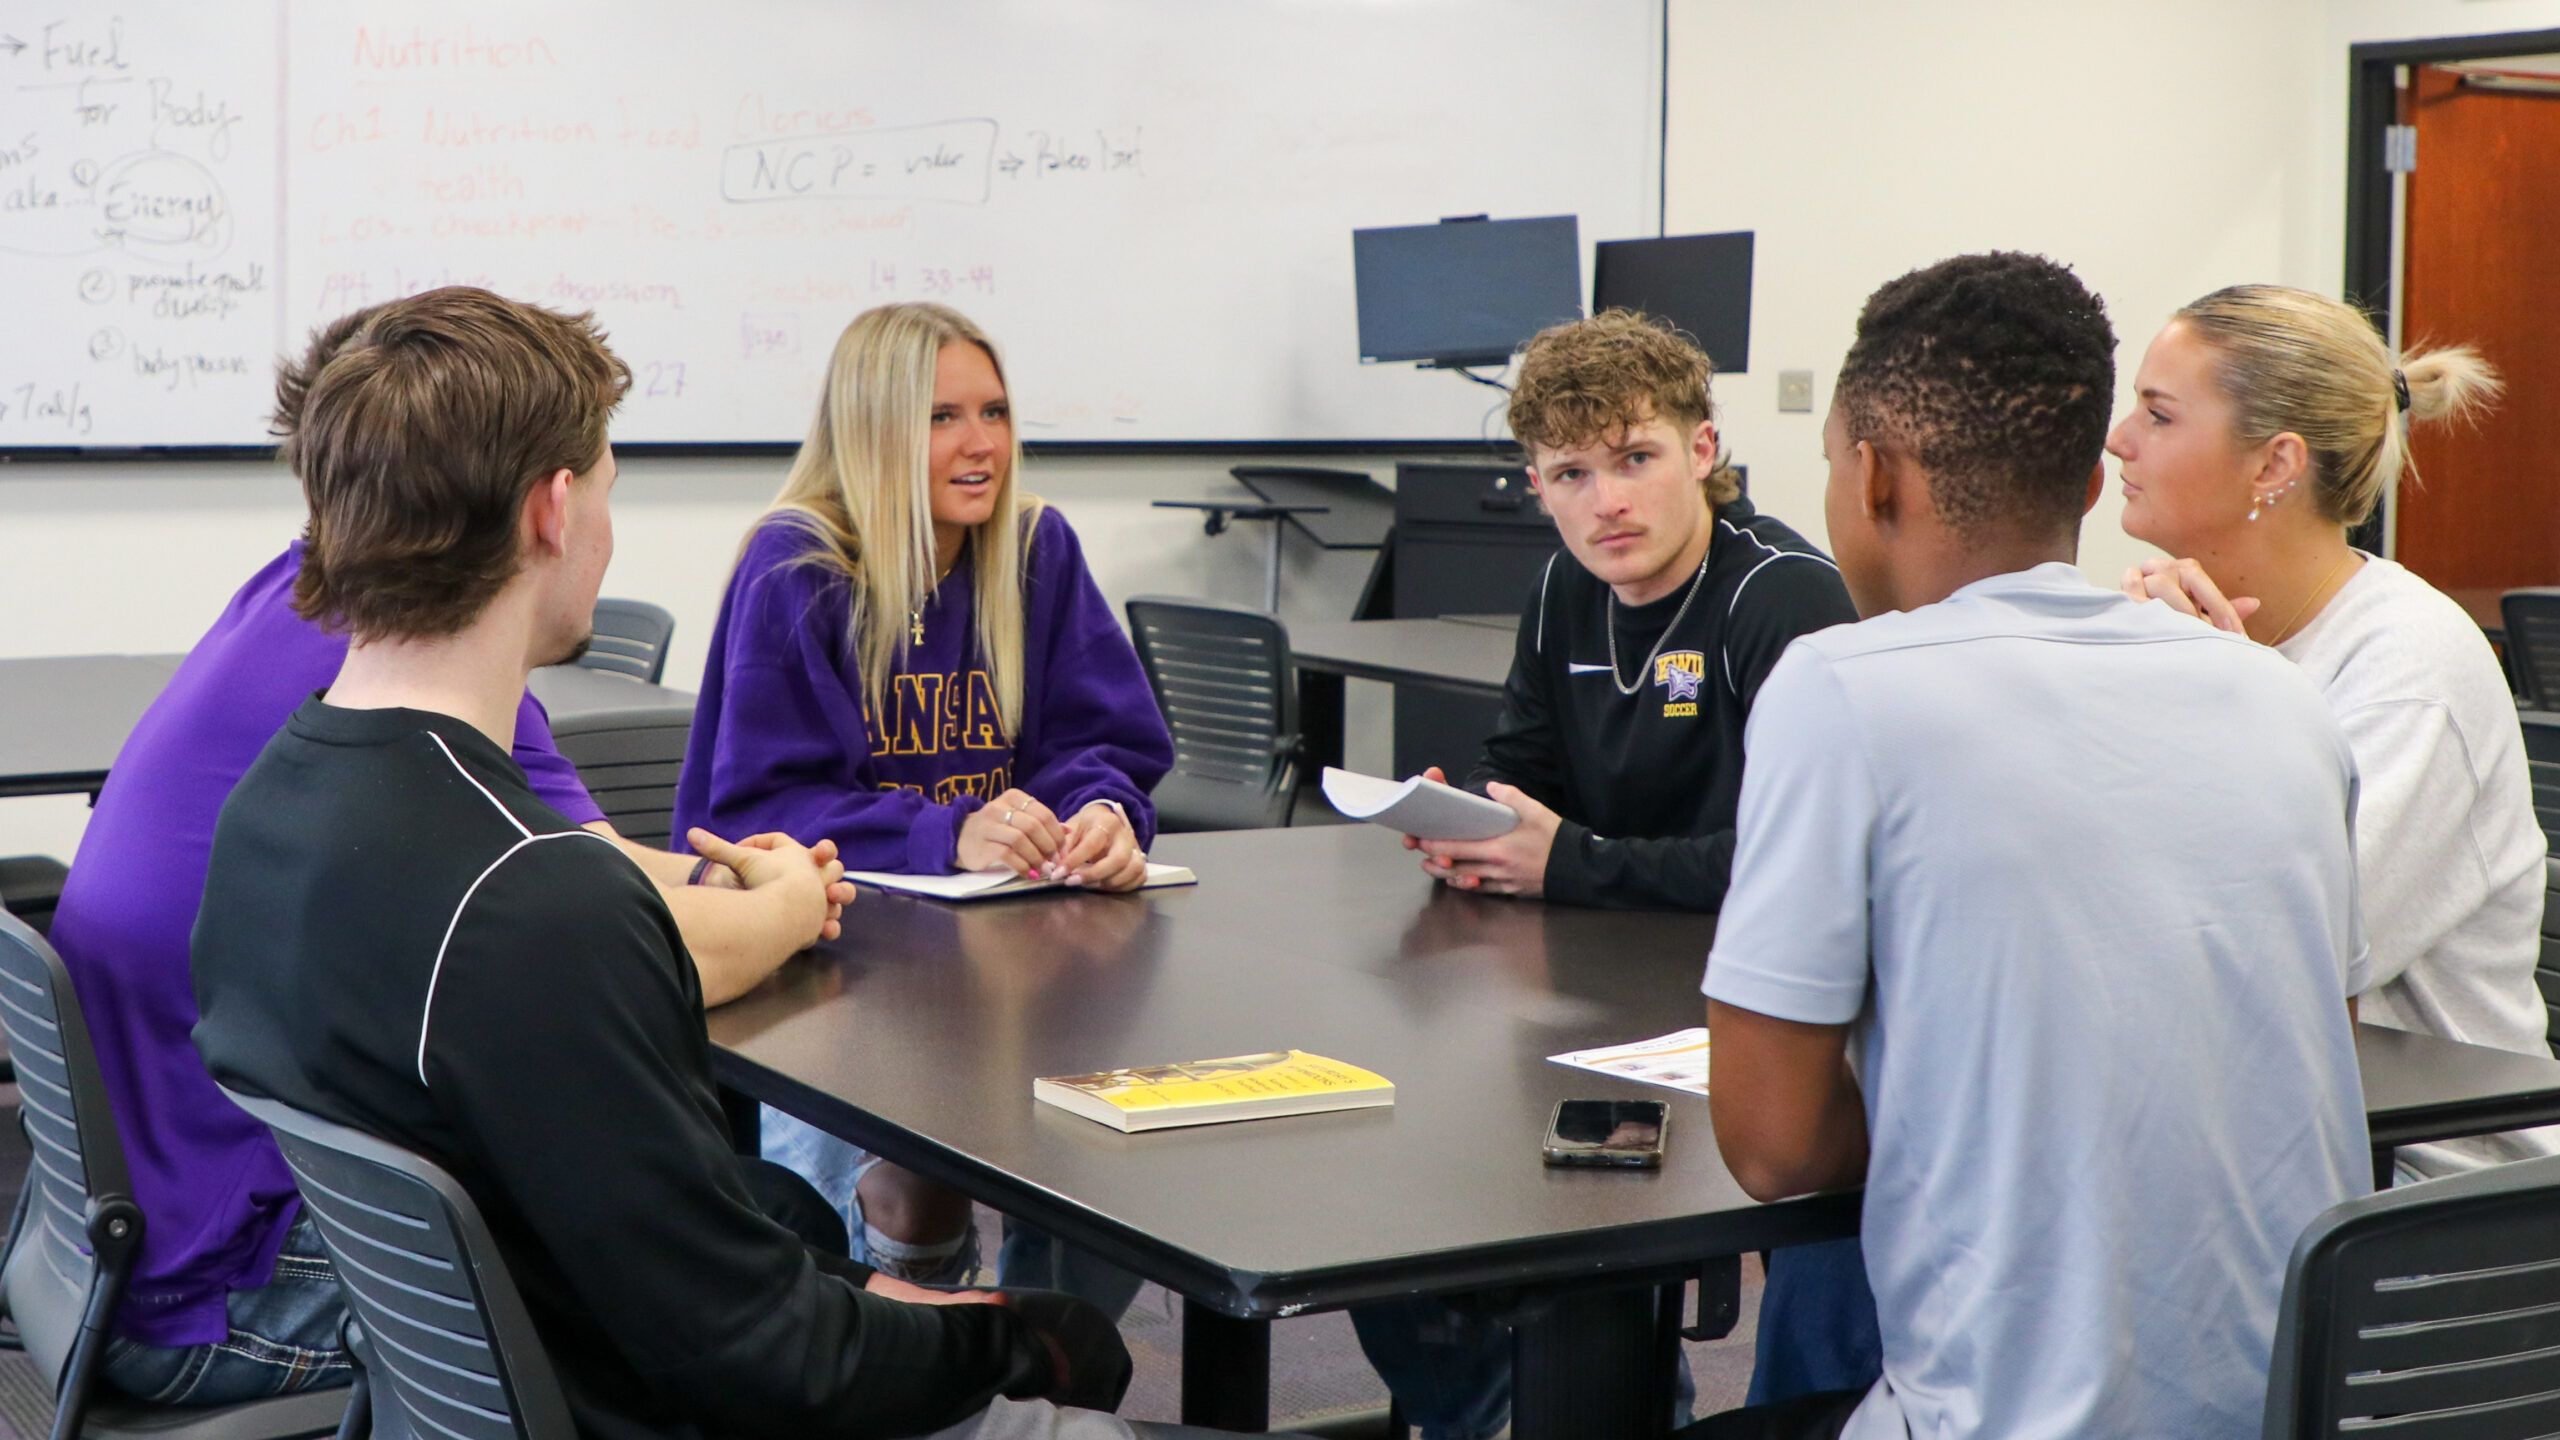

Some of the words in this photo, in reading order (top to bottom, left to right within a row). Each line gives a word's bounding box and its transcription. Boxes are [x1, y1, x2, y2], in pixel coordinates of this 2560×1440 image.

[43, 15, 129, 70] Fuel
[353, 24, 557, 70] Nutrition
[147, 76, 243, 162] Body
[421, 107, 597, 149] Nutrition
[1655, 652, 1705, 682] KWU
[1663, 702, 1698, 718] SOCCER
